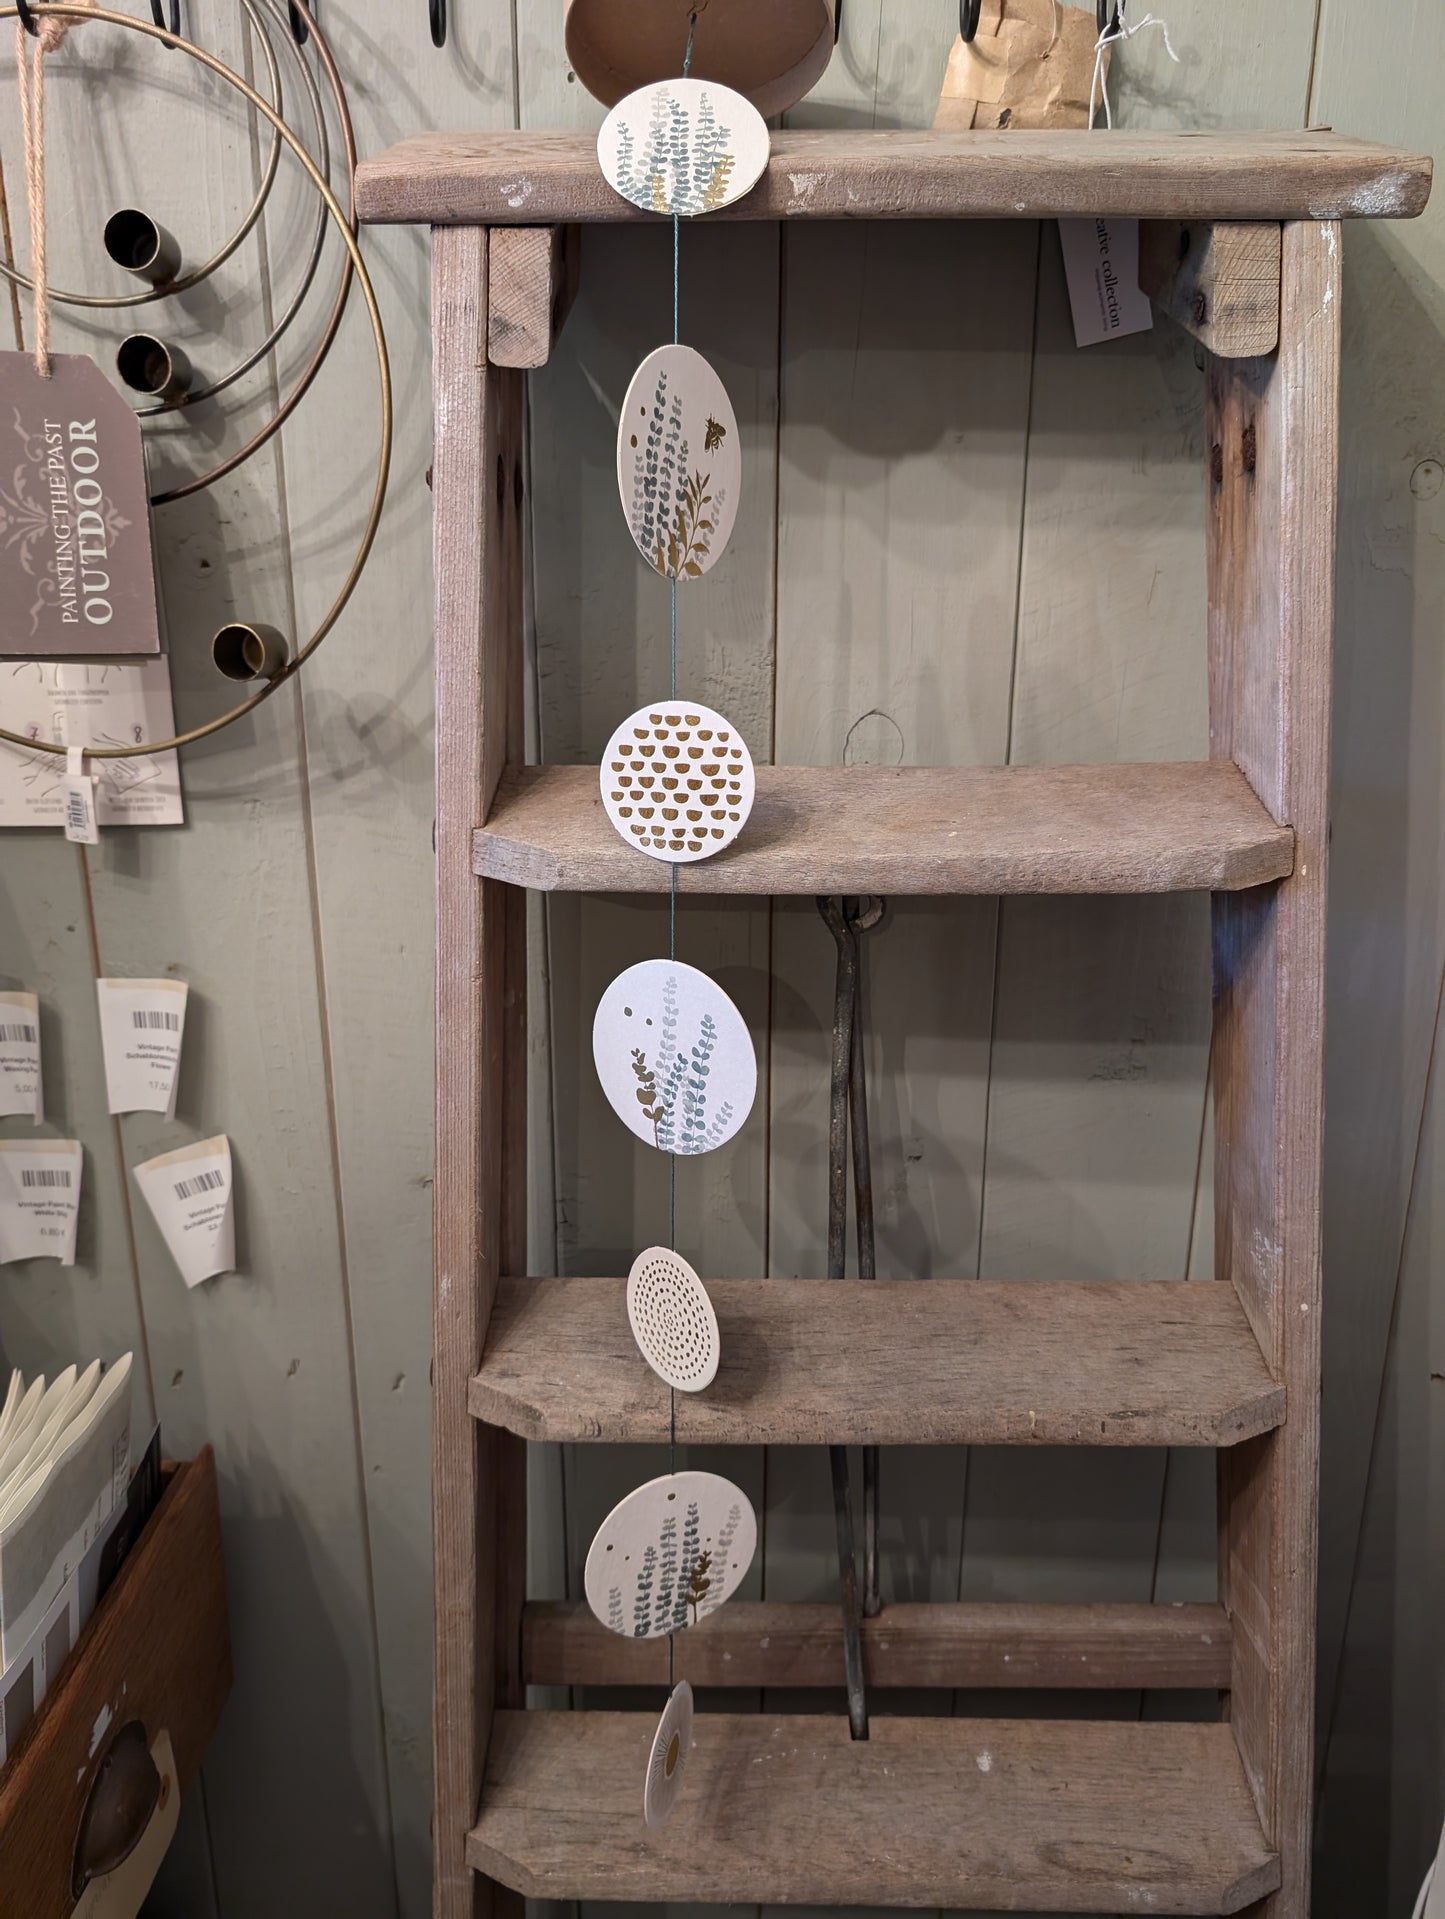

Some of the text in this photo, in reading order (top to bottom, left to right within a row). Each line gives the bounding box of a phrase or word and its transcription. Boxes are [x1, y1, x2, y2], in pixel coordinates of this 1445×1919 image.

[1102, 260, 1122, 328] collection
[44, 418, 79, 623] PAINTING THE PAST
[68, 418, 113, 625] OUTDOOR
[134, 726, 142, 743] 8
